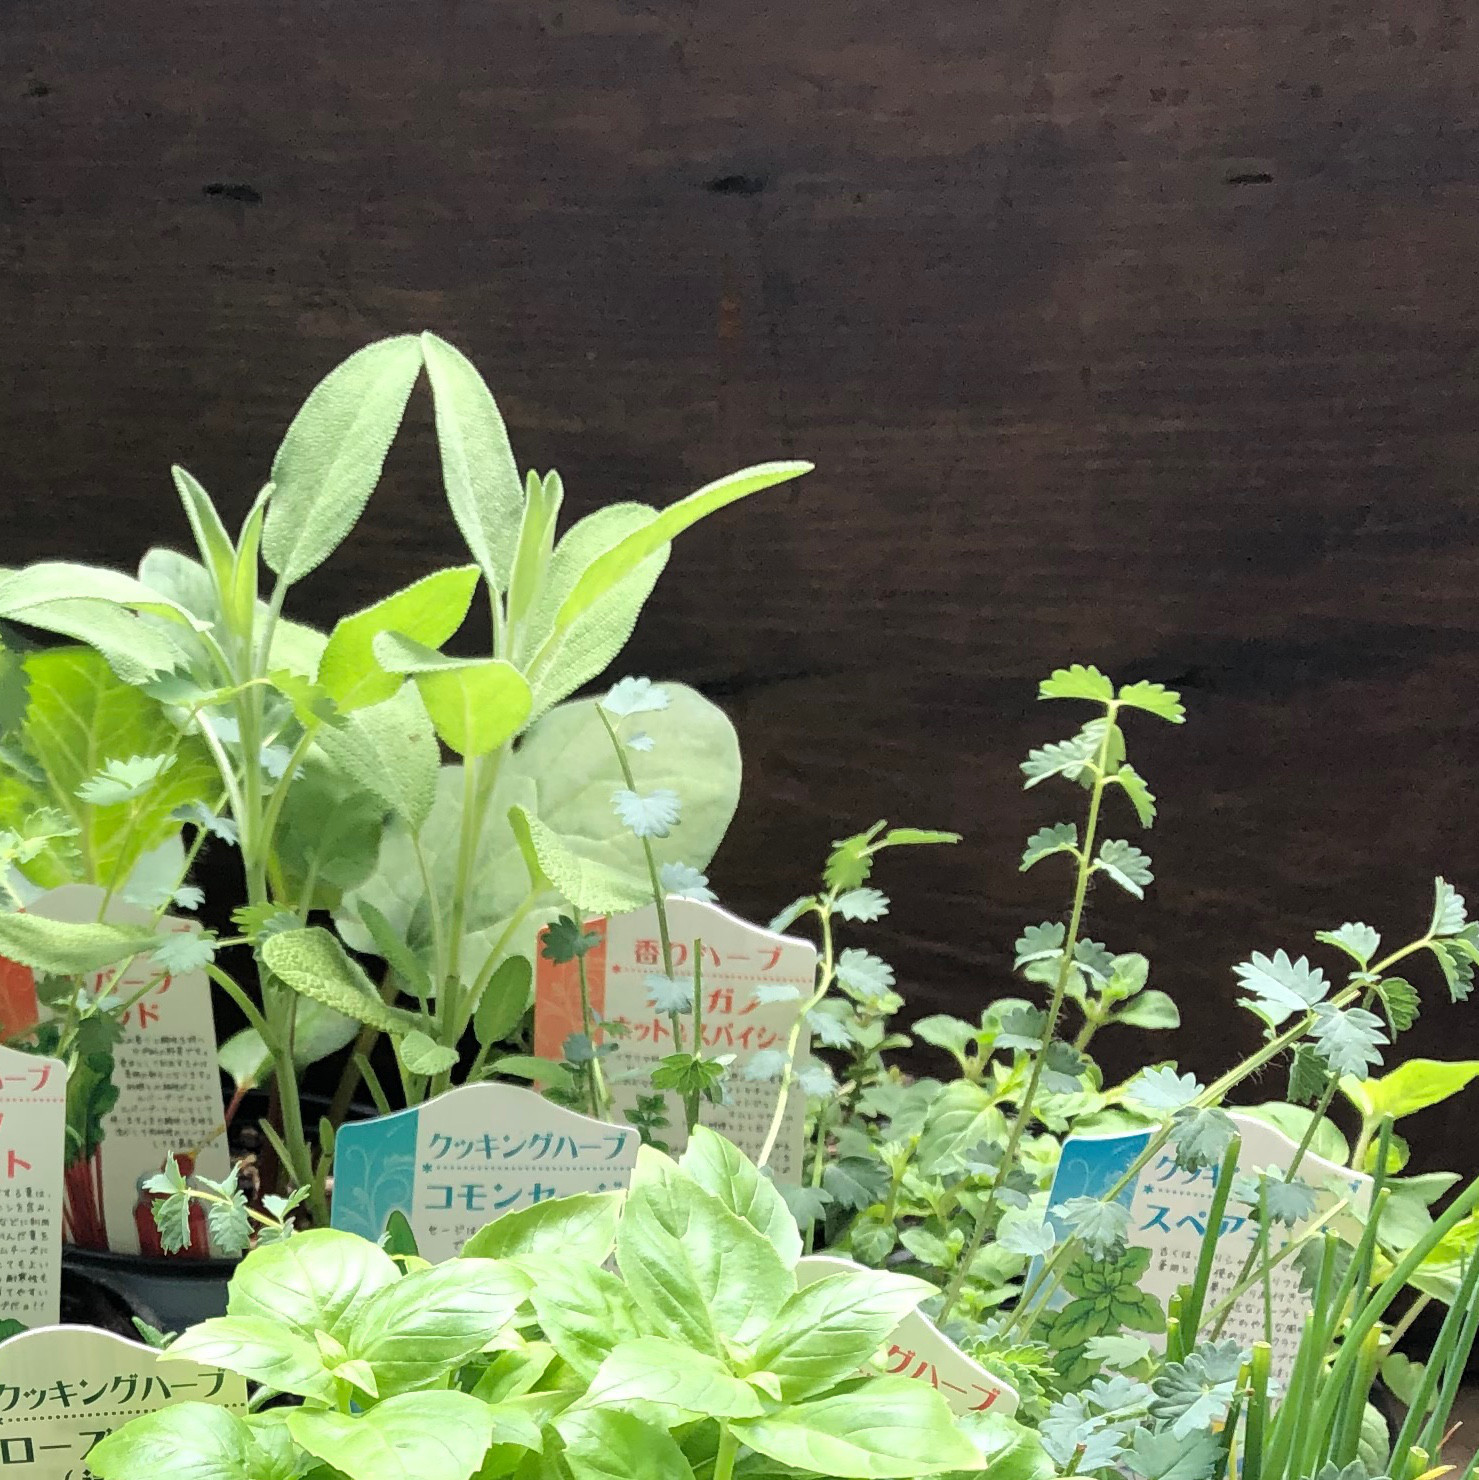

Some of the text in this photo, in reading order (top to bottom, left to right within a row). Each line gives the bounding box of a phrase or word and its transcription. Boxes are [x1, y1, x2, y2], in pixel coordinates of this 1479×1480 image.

[428, 1131, 627, 1160] クッキングハーブ
